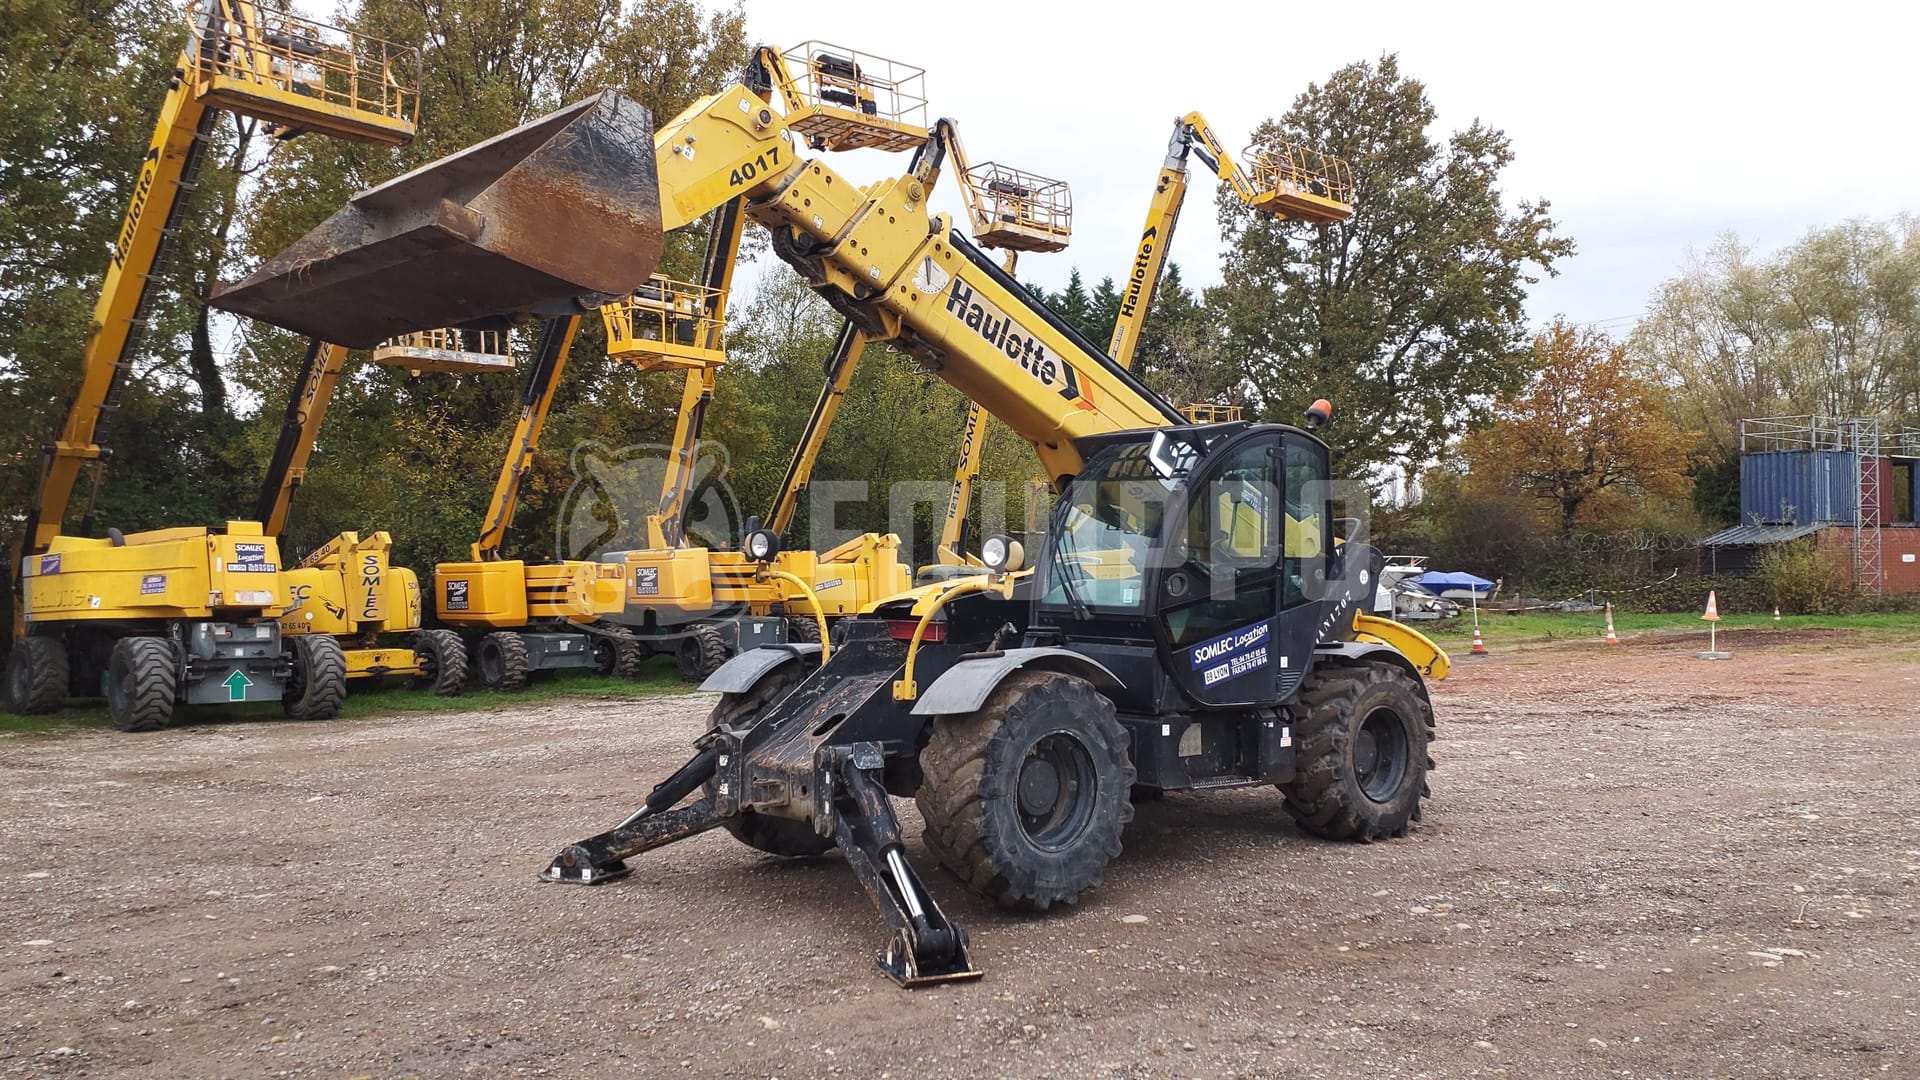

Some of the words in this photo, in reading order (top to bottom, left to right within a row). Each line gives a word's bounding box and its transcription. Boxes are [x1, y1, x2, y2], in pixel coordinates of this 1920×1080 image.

[729, 146, 779, 187] 4017
[114, 169, 153, 271] Haulotte
[1121, 243, 1152, 318] Haulotte
[946, 277, 1057, 386] Haulotte
[306, 342, 331, 405] SOMLE
[959, 402, 980, 472] SOMLE
[235, 544, 265, 552] SOMLEC
[362, 555, 380, 619] SOMLEC
[1194, 636, 1233, 664] SOMLEC
[1234, 624, 1268, 648] Location
[1214, 665, 1229, 680] LYON
